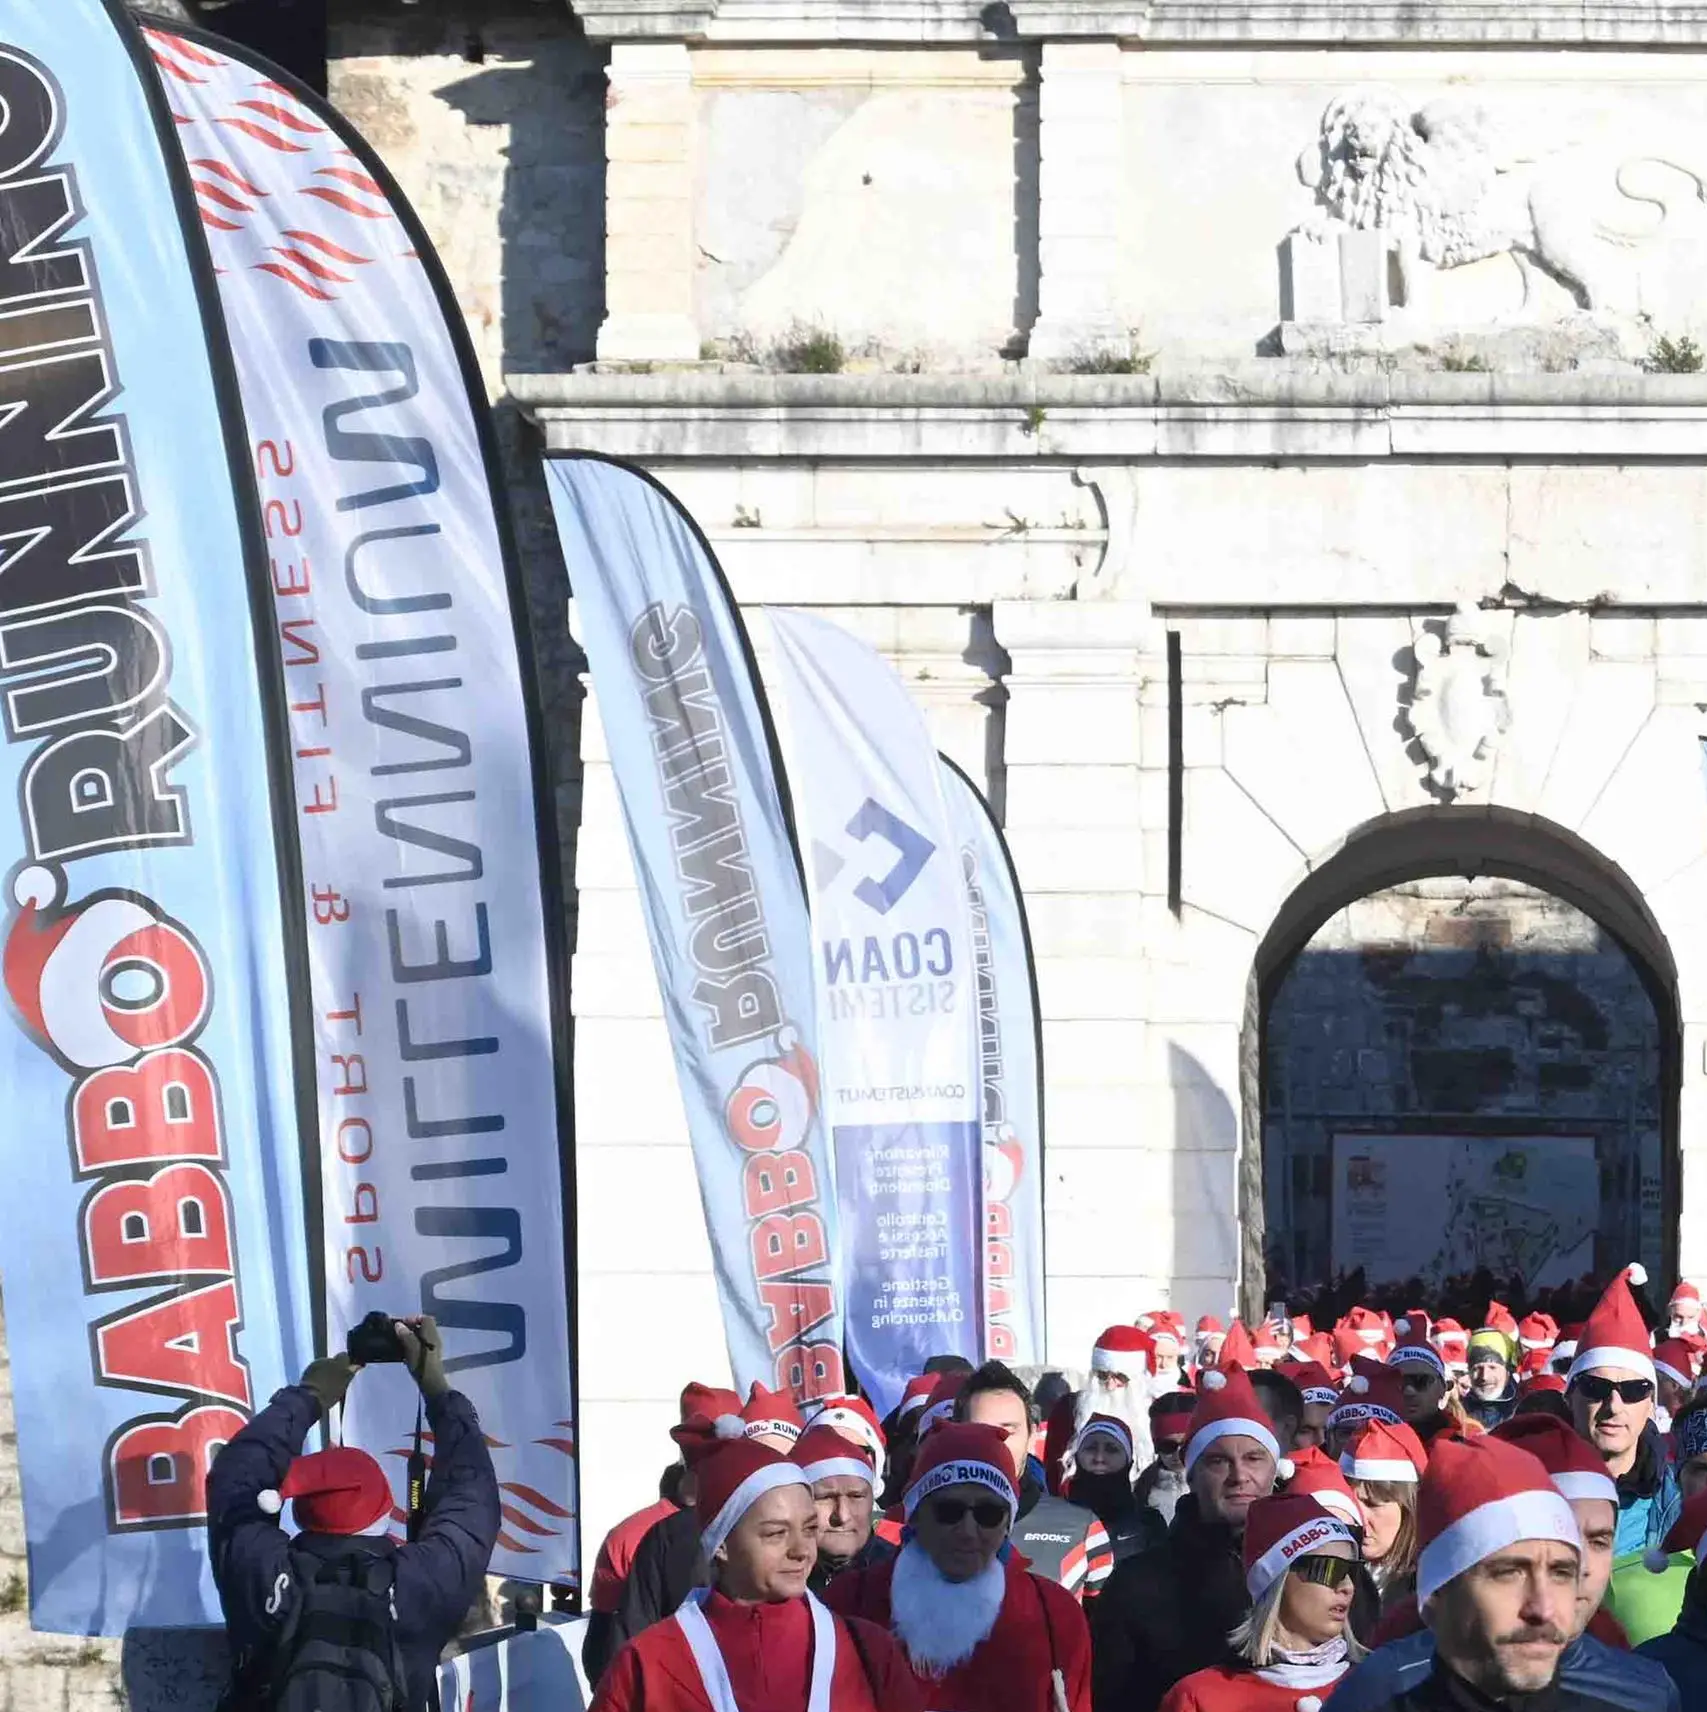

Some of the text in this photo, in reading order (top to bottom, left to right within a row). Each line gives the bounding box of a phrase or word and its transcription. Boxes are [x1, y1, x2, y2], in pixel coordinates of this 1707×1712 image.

[50, 893, 257, 1532] BABBO
[411, 1479, 421, 1510] Nikon
[1023, 1532, 1073, 1544] BROOKS
[1281, 1525, 1330, 1559] BABBO
